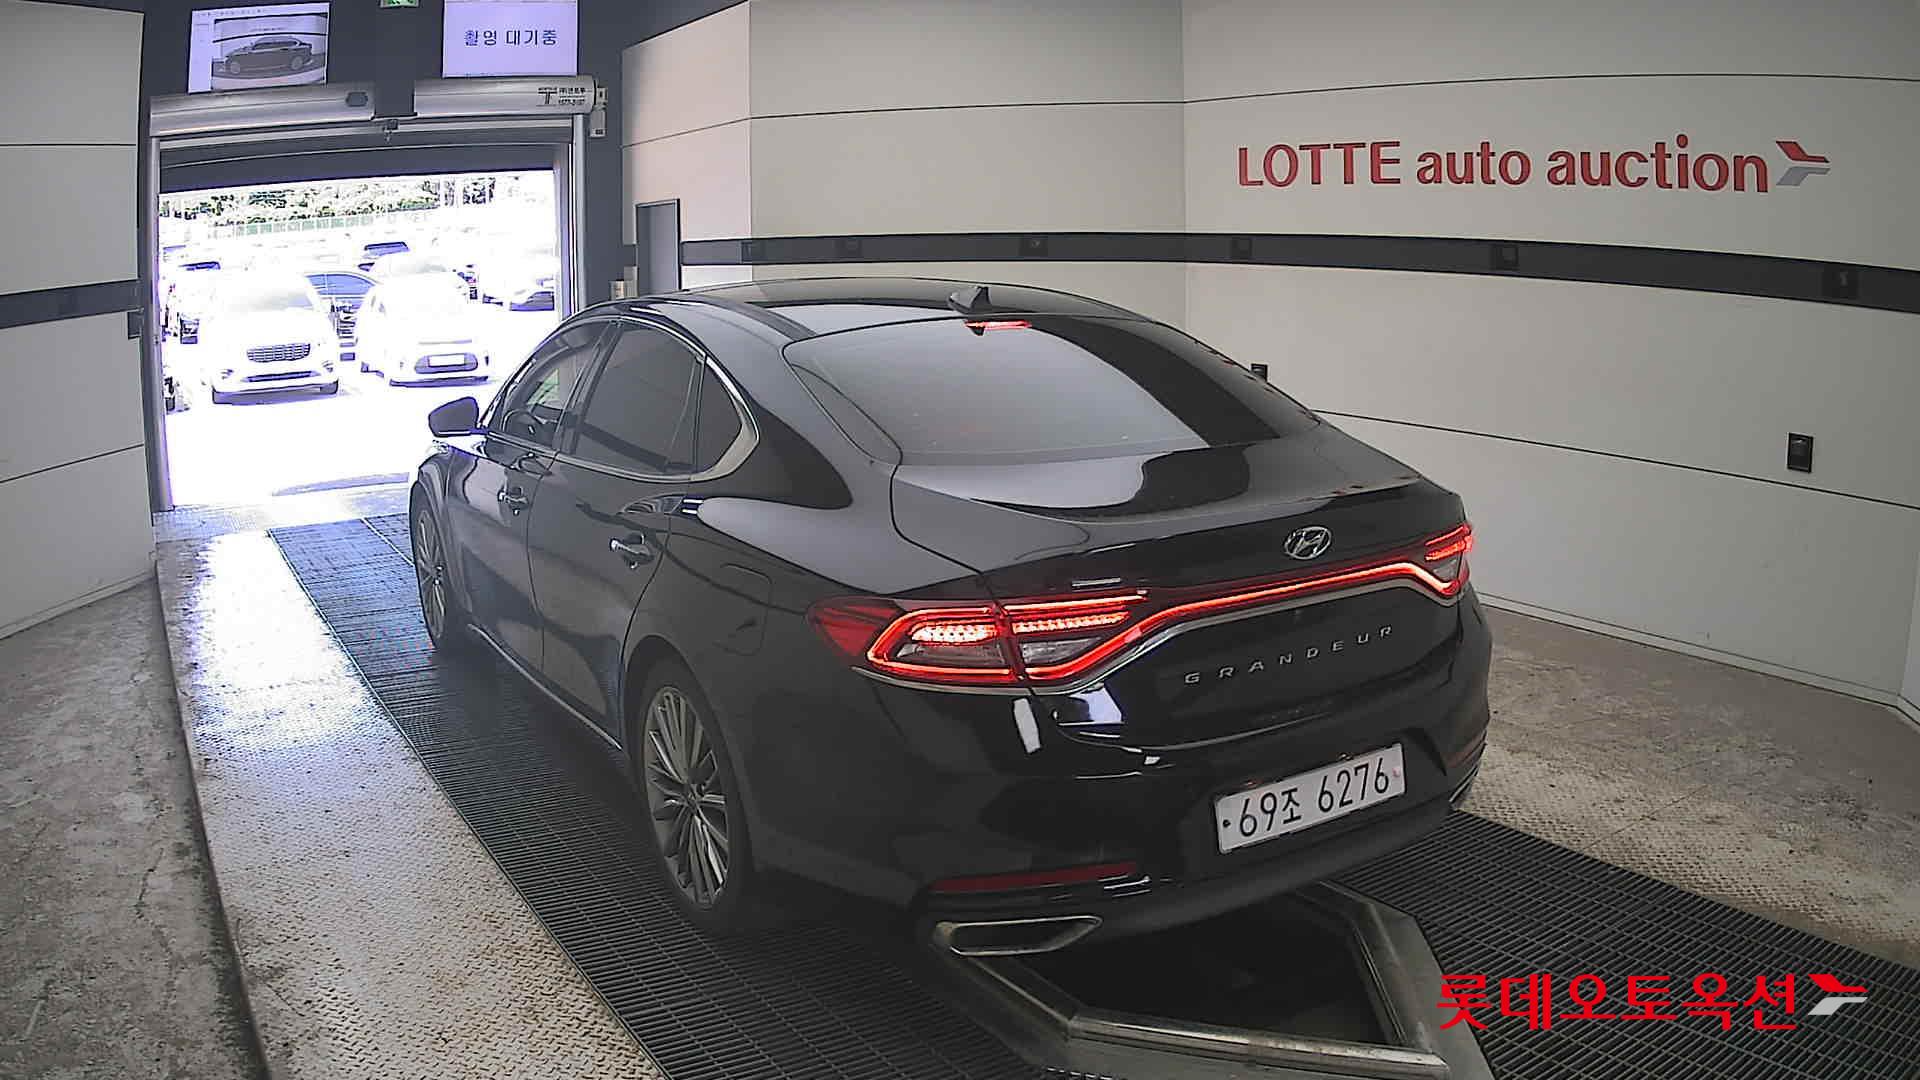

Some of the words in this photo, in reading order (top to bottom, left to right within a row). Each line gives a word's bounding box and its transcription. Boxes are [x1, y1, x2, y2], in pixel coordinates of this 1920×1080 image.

[505, 29, 557, 46] 대기중
[1237, 140, 1401, 188] LOTTE
[1416, 141, 1531, 186] auto
[1547, 133, 1769, 193] auction
[1184, 625, 1393, 684] GRANDEUR
[1239, 787, 1302, 838] 69조
[1317, 757, 1390, 813] 6276
